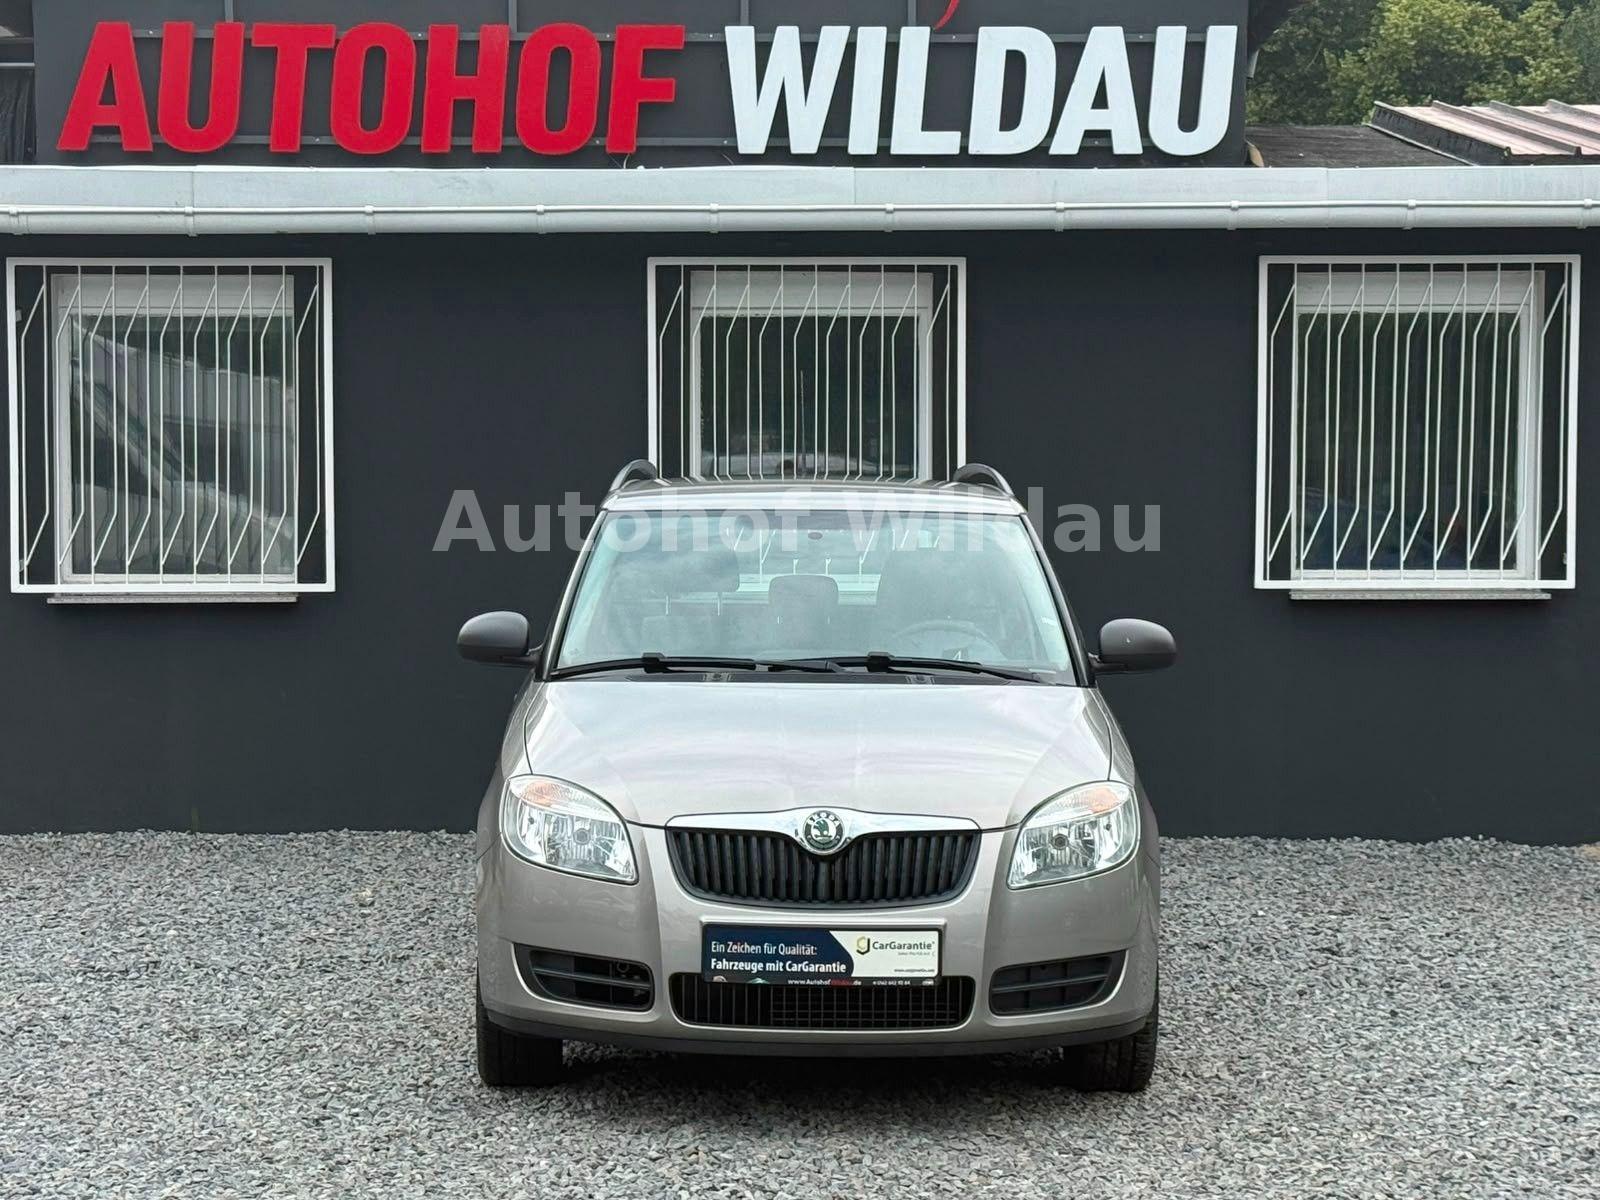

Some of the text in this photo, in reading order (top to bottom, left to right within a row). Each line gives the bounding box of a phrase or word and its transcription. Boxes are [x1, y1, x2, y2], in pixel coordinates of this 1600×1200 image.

[56, 21, 1237, 156] AUTOHOF WILDAU
[711, 941, 818, 956] Ein Zeichen für Qualität:
[711, 958, 847, 973] Fahrzeuge mit CarGarantie
